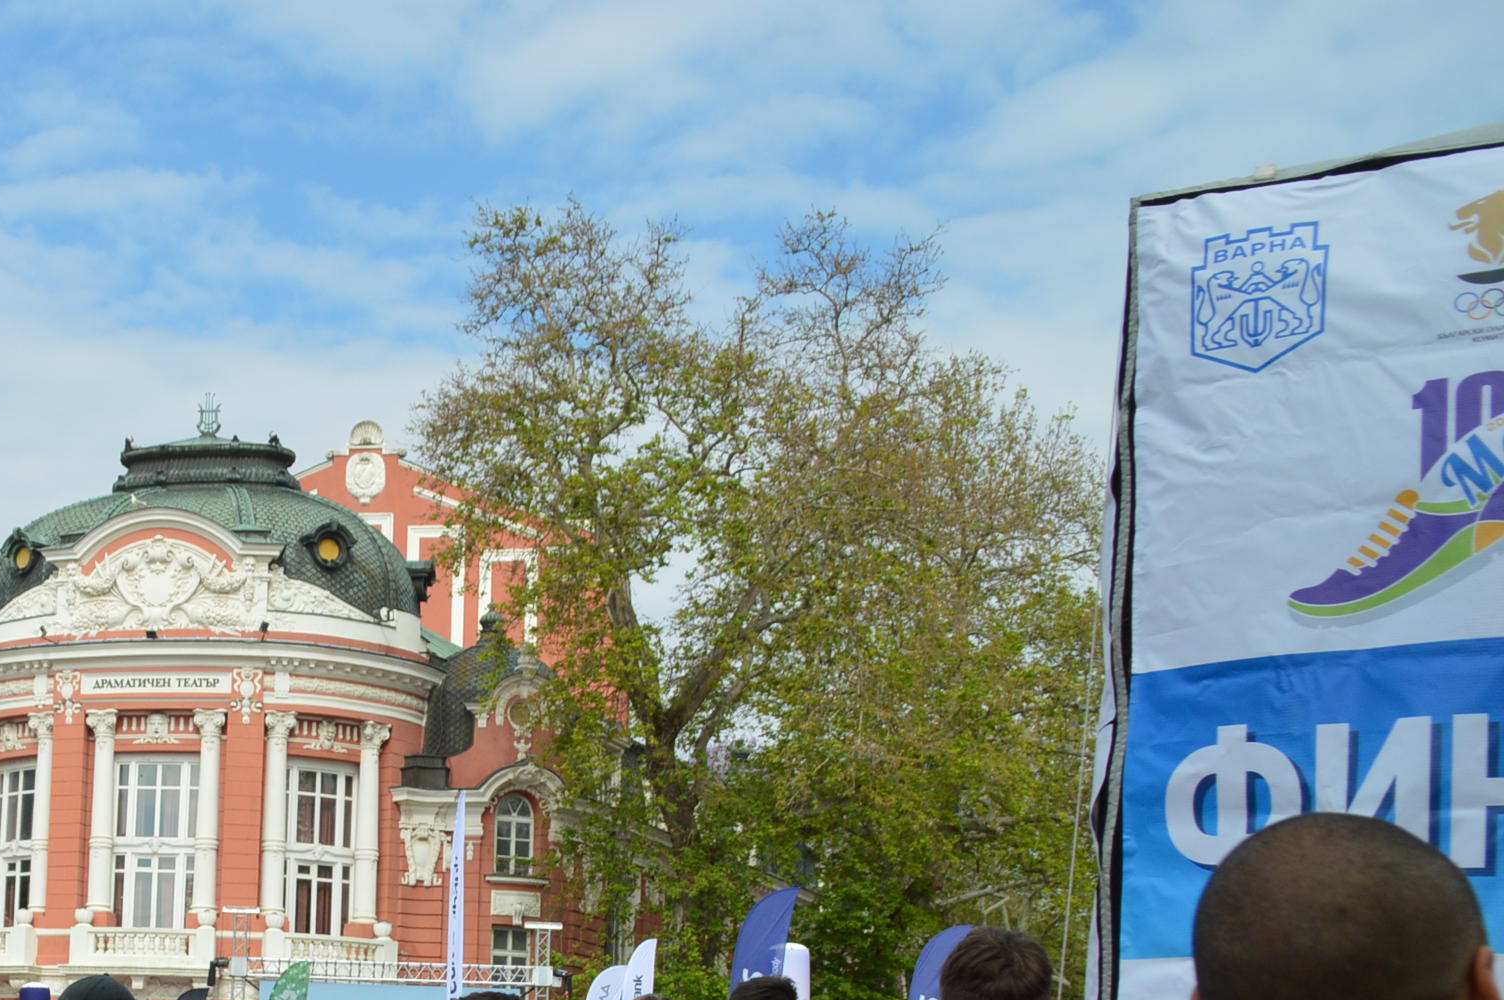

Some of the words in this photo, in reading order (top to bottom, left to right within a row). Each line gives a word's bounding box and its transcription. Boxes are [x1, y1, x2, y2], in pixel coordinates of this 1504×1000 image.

[1214, 235, 1307, 264] ВАРНА
[93, 678, 171, 689] ДРАМАТИЧЕН
[176, 678, 220, 688] ТЕАТЪР
